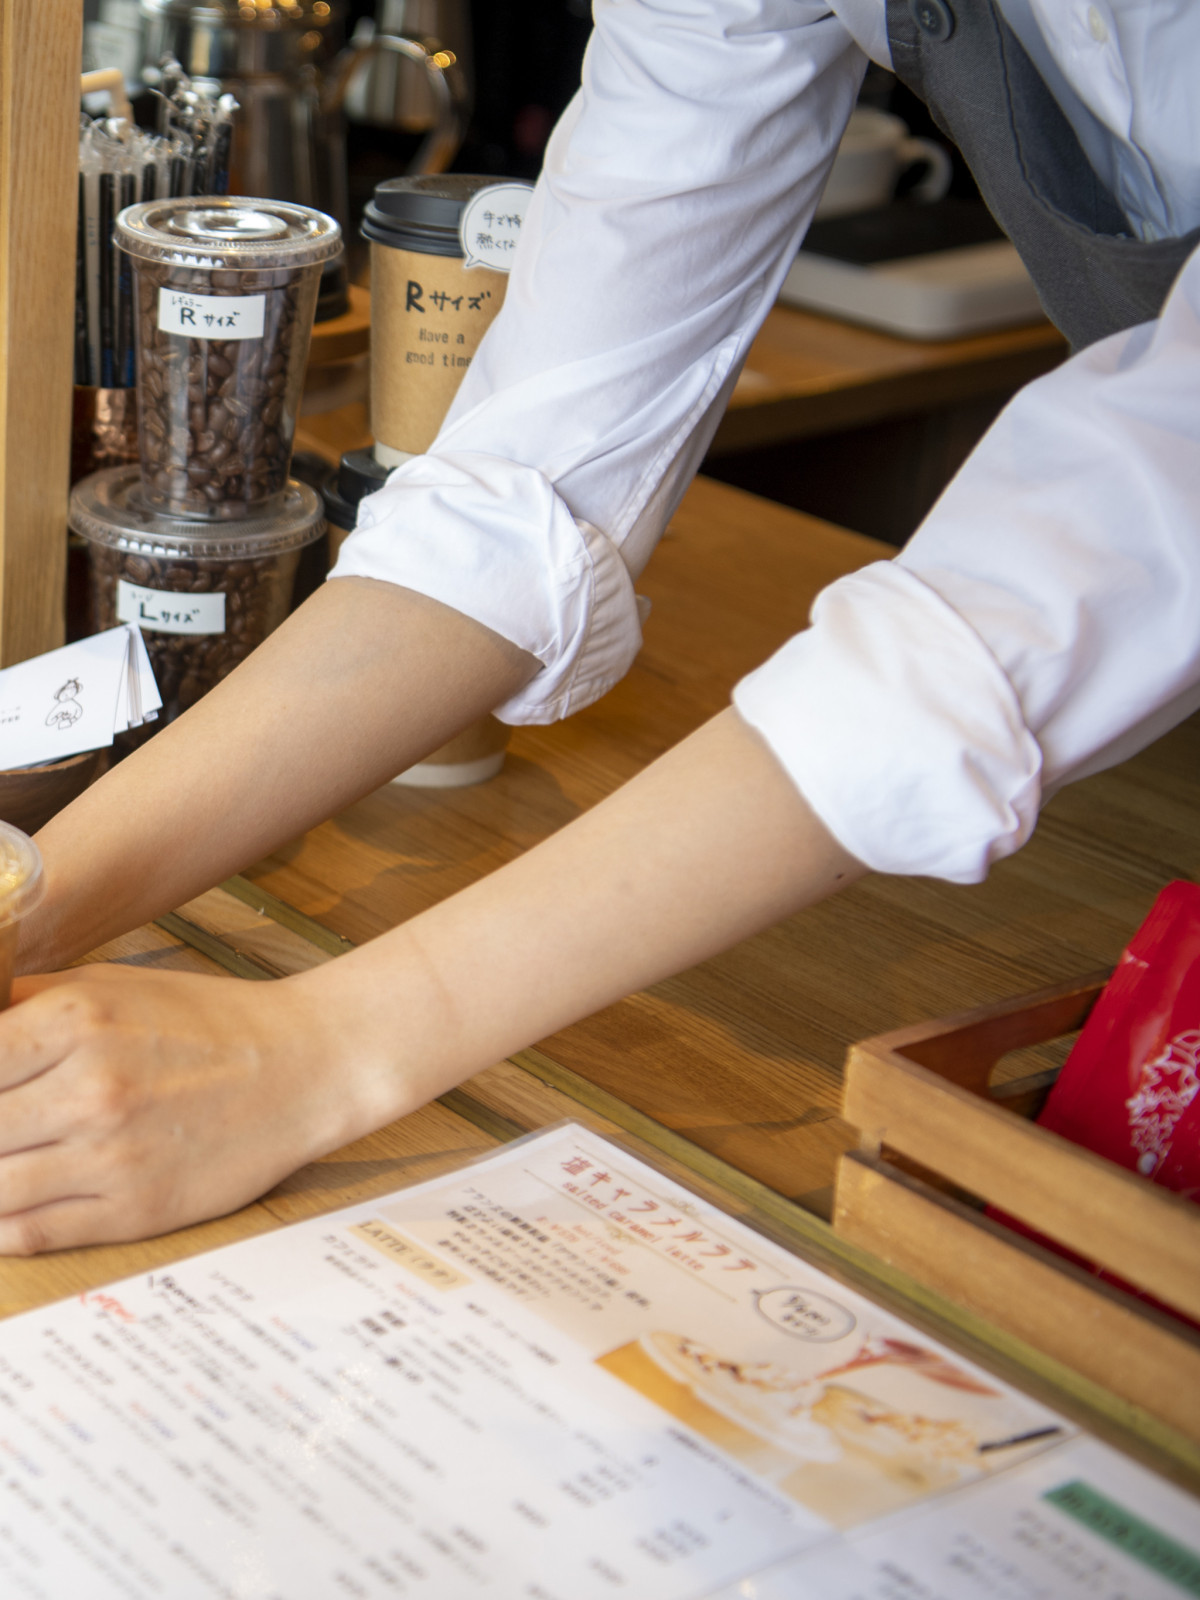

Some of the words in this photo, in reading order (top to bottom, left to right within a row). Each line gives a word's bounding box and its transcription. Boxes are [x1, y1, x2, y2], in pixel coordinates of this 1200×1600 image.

[419, 327, 450, 344] Have
[456, 333, 465, 345] a
[406, 351, 435, 366] good
[560, 1156, 757, 1272] 塩キャラメルラテ
[562, 1182, 610, 1211] salted
[608, 1211, 664, 1244] caramel
[665, 1245, 705, 1271] latte
[356, 1220, 413, 1257] LATTE
